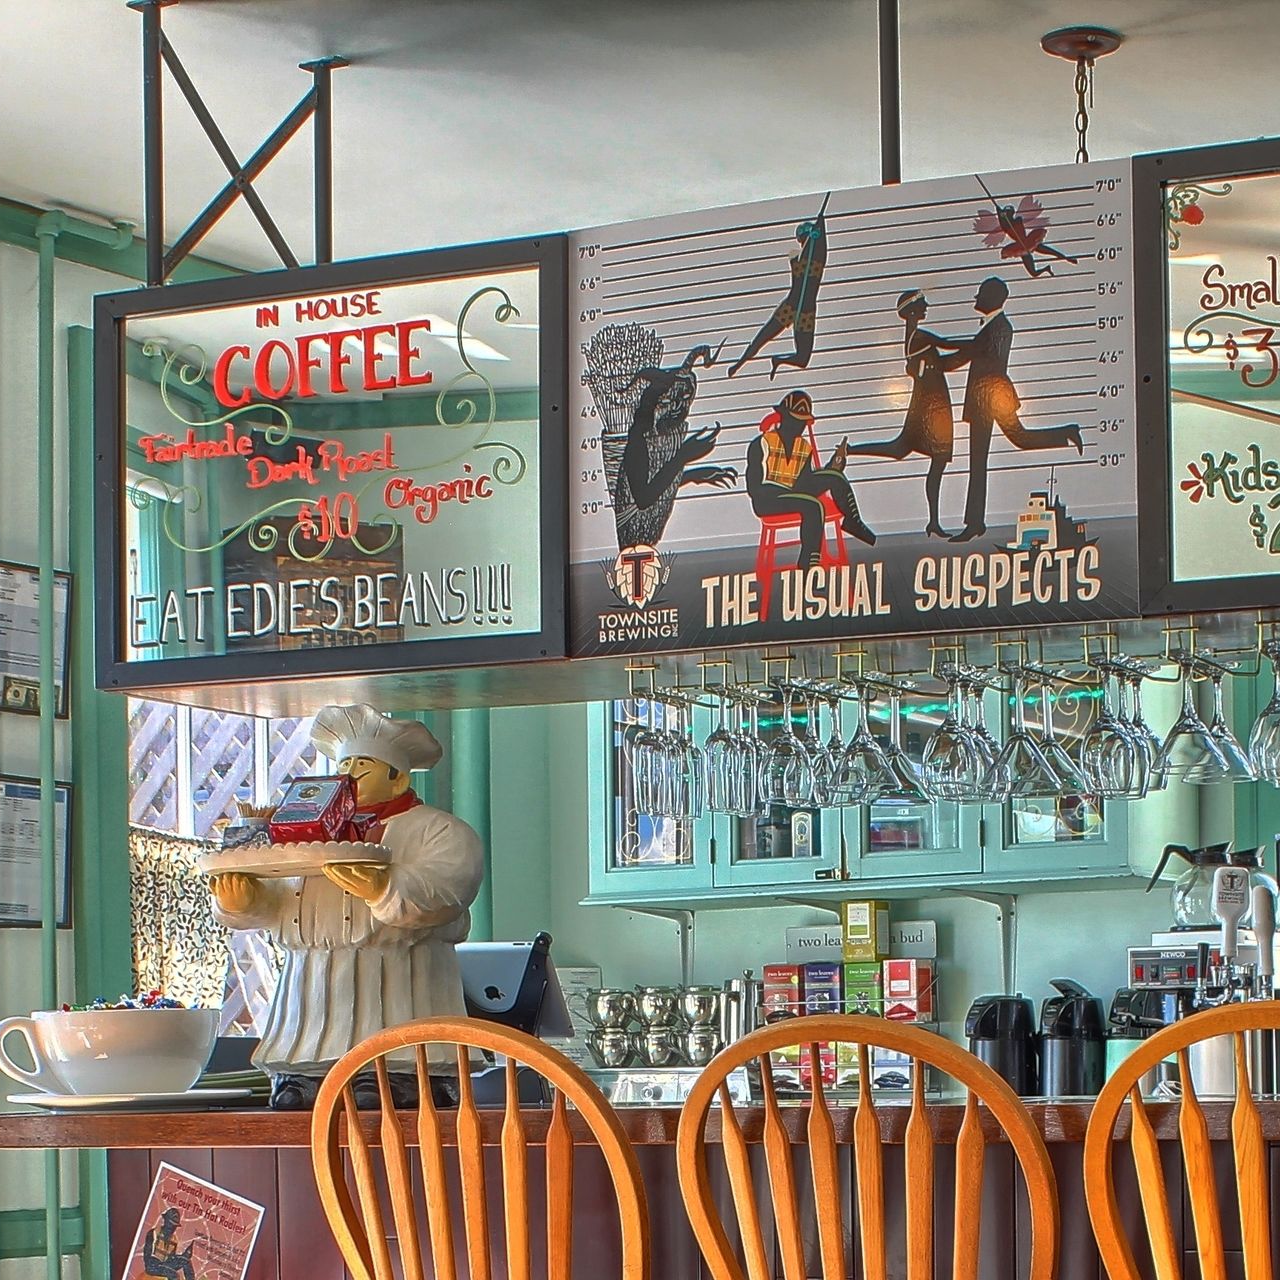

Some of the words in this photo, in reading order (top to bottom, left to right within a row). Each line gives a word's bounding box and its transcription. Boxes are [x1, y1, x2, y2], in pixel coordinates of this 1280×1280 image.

[256, 306, 279, 329] IN
[296, 290, 381, 321] HOUSE
[213, 319, 433, 409] COFFEE
[1223, 326, 1279, 389] $3
[581, 405, 597, 419] 4'6
[138, 423, 254, 464] Fairtrade
[246, 448, 320, 488] Dark
[316, 433, 399, 475] Roast
[384, 463, 494, 524] Organic
[298, 491, 359, 543] $10
[130, 585, 215, 648] EAT
[227, 574, 344, 639] EDIE'S
[353, 562, 514, 631] BEANS!!!
[701, 574, 758, 629] THE
[780, 560, 891, 623] USUAL
[913, 545, 1102, 612] SUSPECTS
[598, 608, 678, 630] TOWNSITE
[599, 624, 671, 643] BREWING
[798, 937, 821, 948] two
[824, 933, 842, 947] lea
[900, 930, 925, 944] bud
[1160, 951, 1186, 959] NEWCO
[176, 1179, 204, 1199] Quench
[204, 1193, 221, 1207] your
[221, 1199, 241, 1216] thirst
[178, 1199, 192, 1210] our
